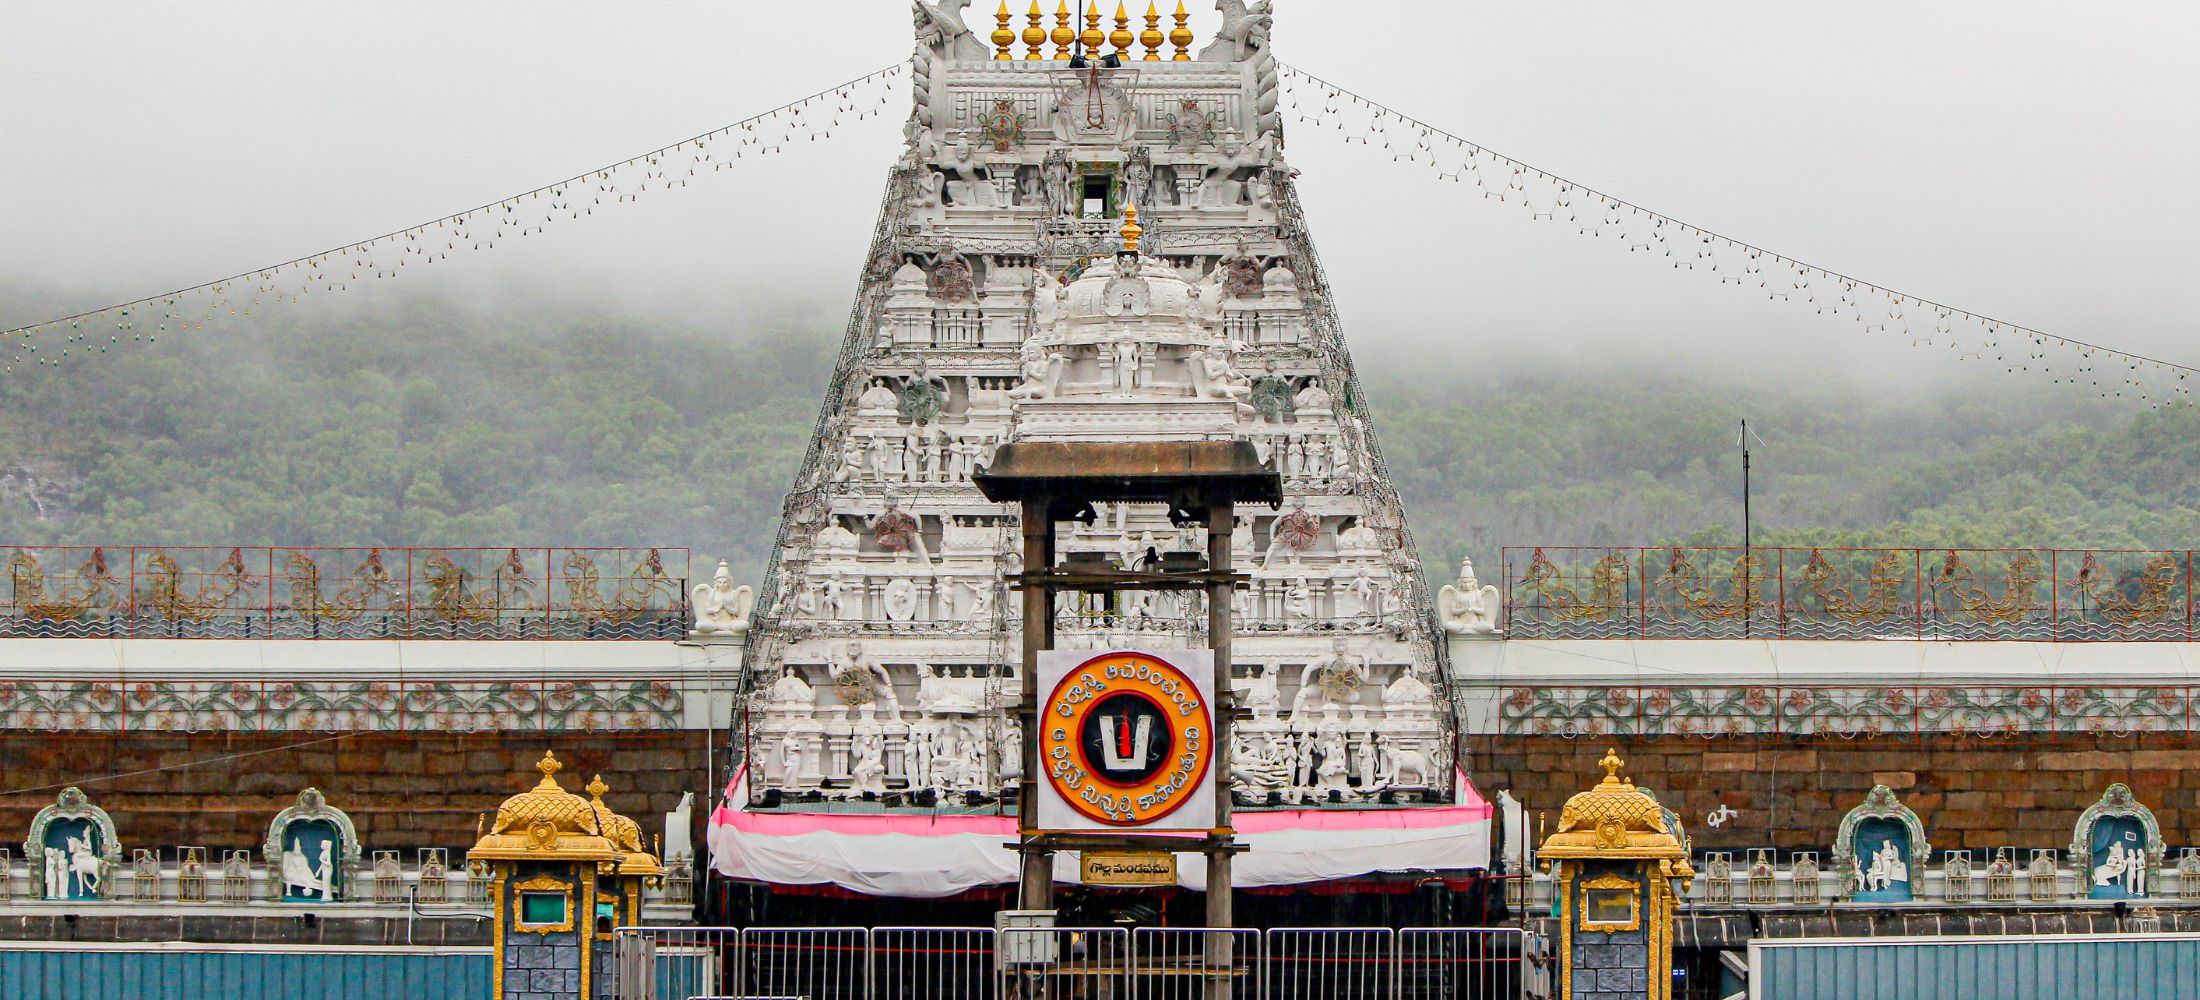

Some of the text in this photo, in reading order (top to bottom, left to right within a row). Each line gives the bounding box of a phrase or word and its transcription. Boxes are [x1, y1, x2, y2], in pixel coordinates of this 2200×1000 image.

[1104, 661, 1200, 716] ఆచరించండి
[1136, 726, 1200, 811] కాపాడుతుంది
[1113, 863, 1170, 874] మండపము
